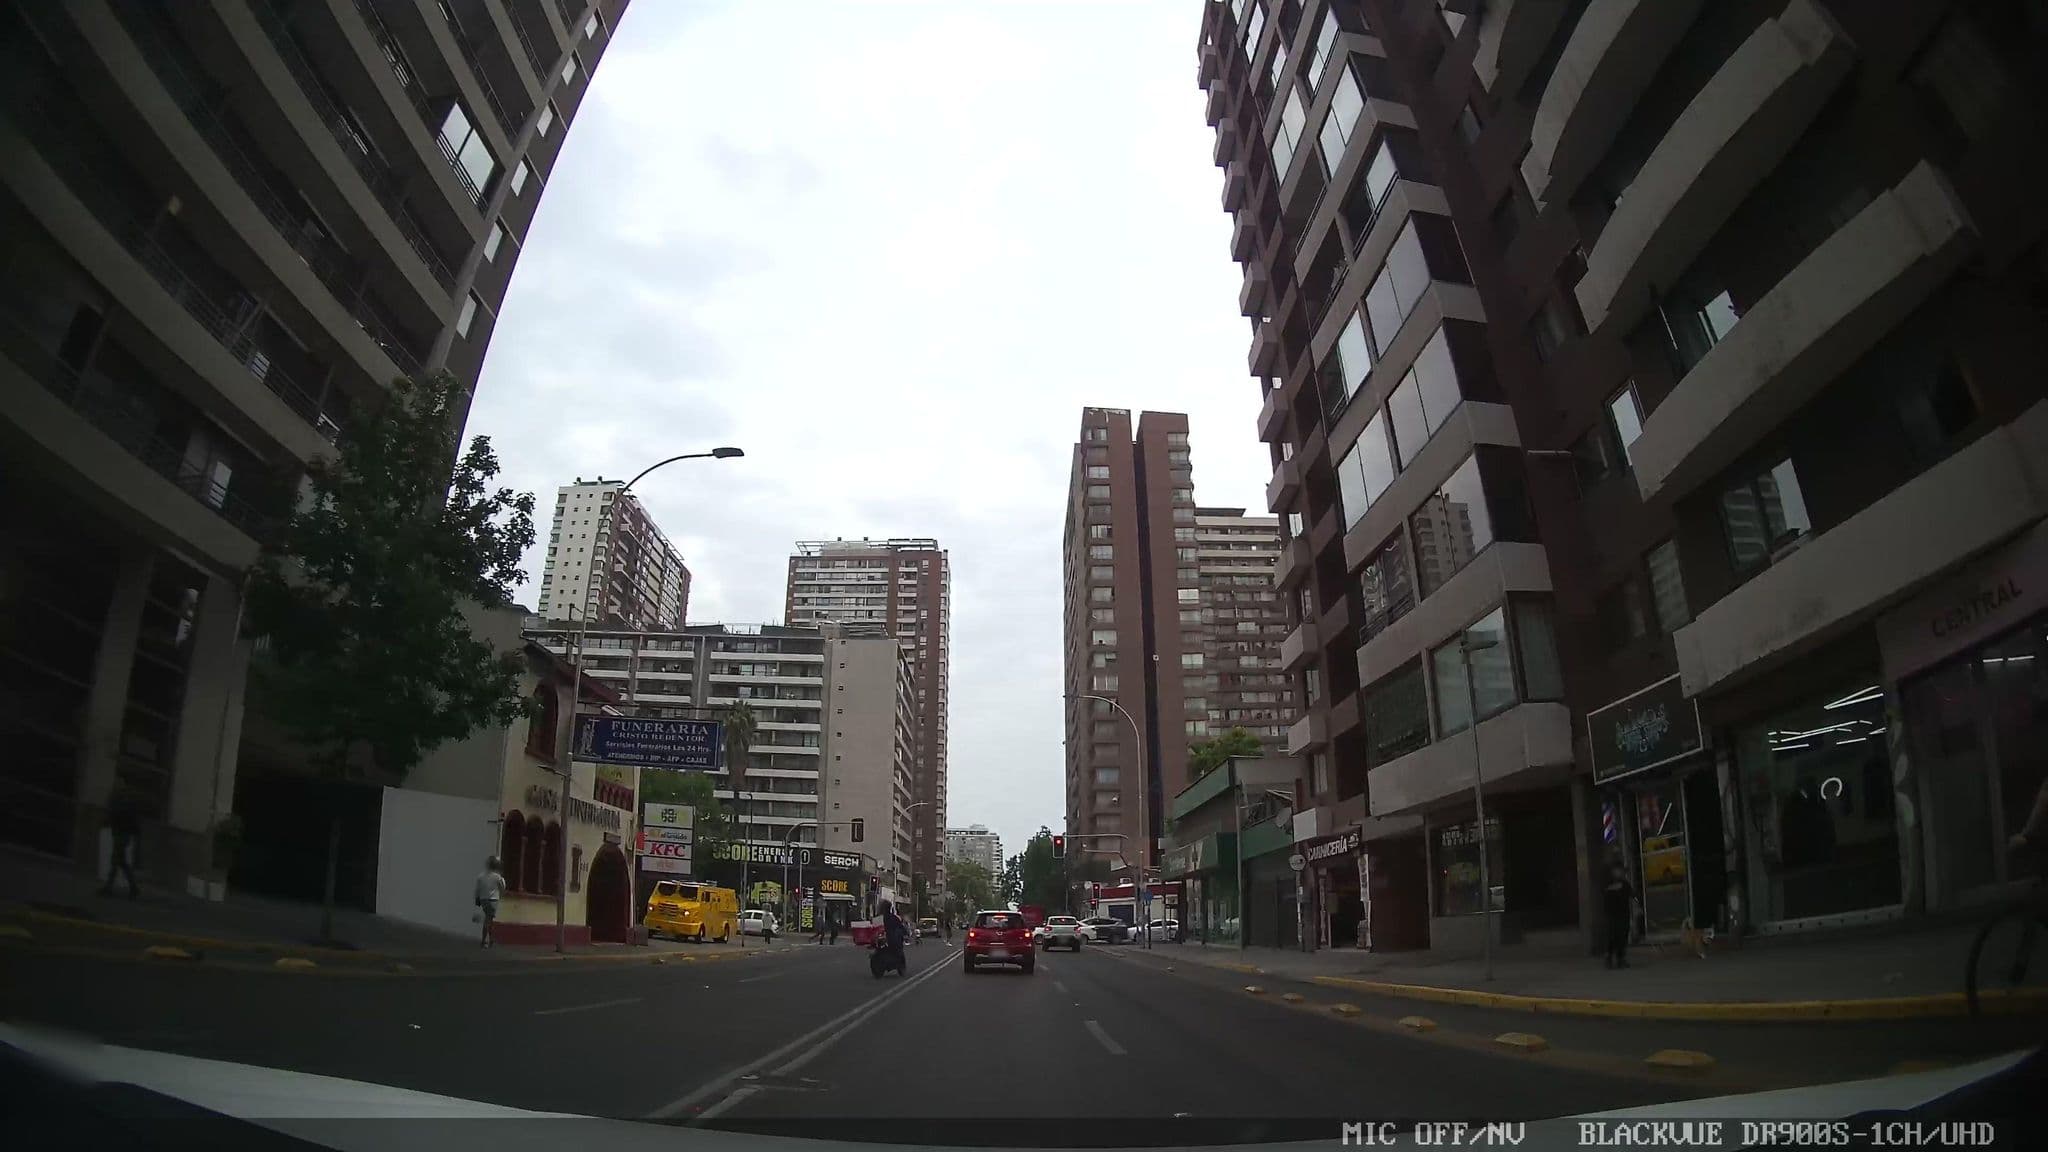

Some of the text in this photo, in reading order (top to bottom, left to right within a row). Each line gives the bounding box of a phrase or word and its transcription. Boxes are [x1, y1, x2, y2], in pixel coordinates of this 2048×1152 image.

[1932, 576, 2023, 637] CENTRAL
[611, 720, 708, 735] FUNERARIA
[613, 731, 705, 742] CRISTO REDENTOR
[650, 843, 685, 857] KFC
[712, 843, 757, 862] SCORE
[758, 854, 794, 865] DRINK
[823, 855, 859, 867] SERCH
[821, 879, 849, 893] SCORE
